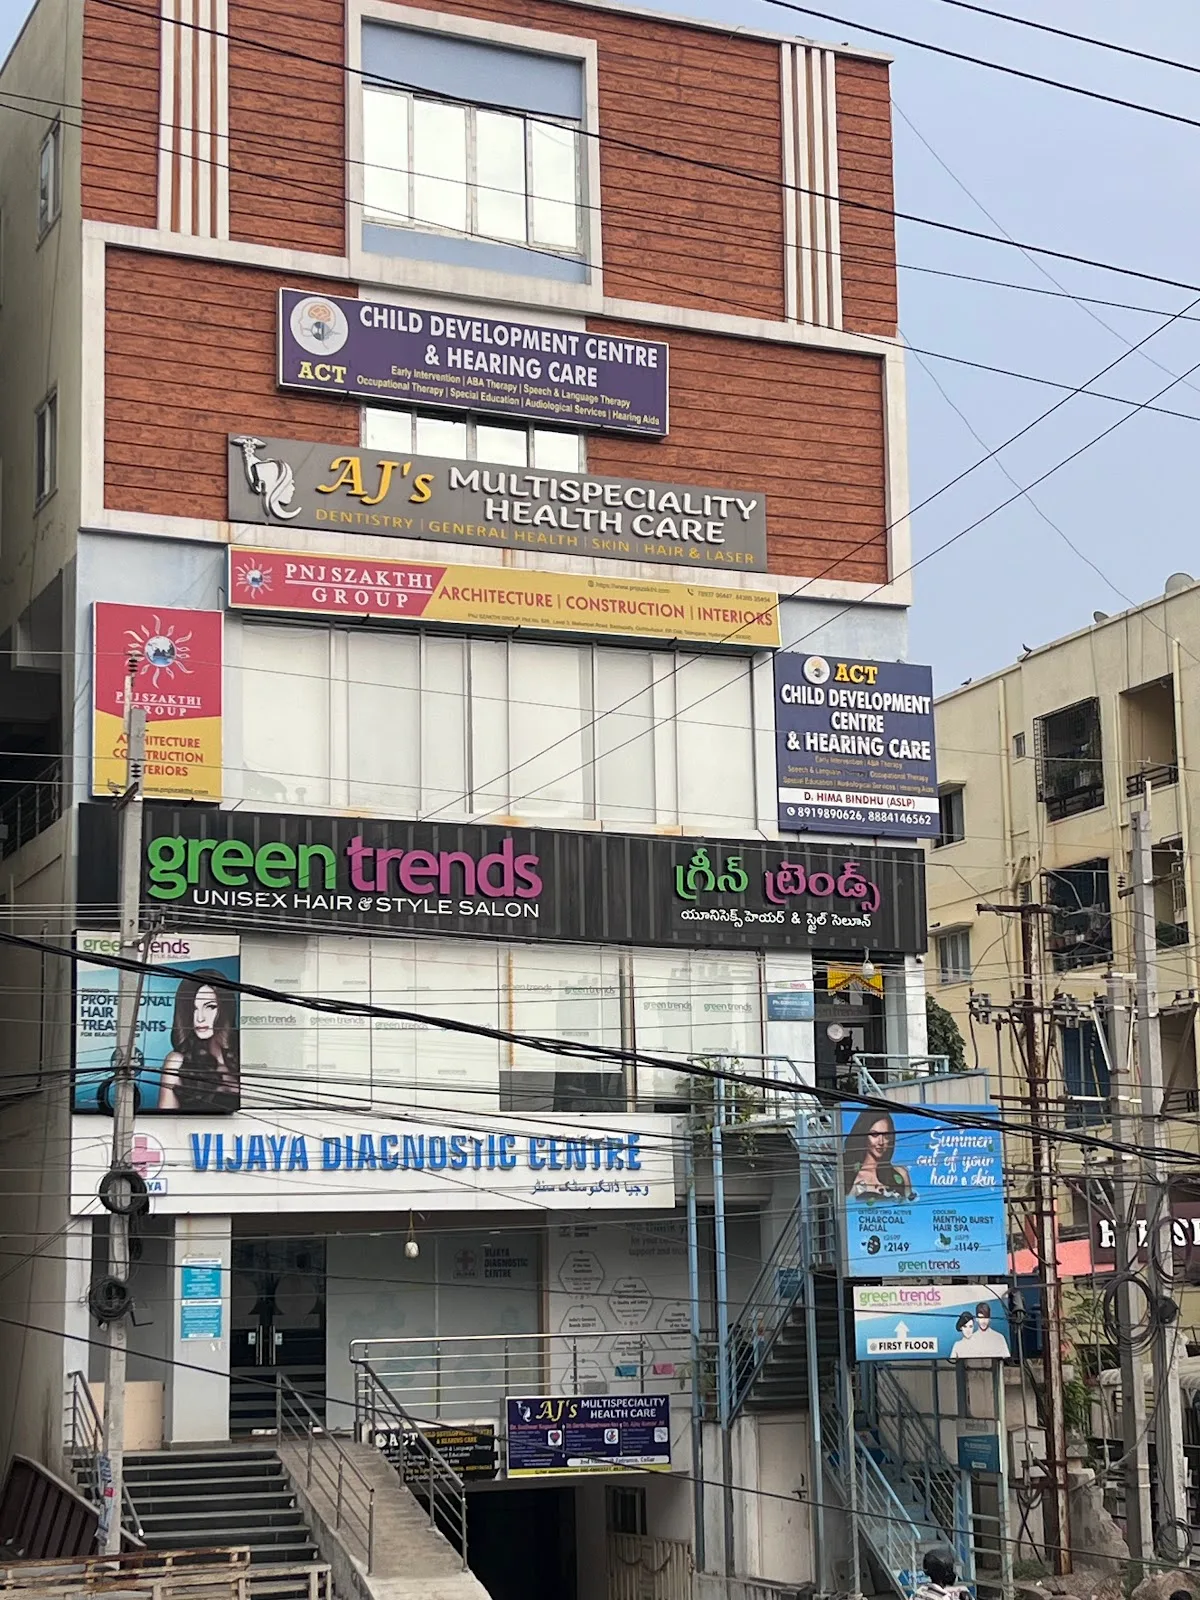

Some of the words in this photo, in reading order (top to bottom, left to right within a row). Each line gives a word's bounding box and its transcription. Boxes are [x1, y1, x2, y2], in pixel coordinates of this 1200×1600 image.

[359, 305, 424, 334] CHILD
[430, 313, 579, 357] DEVELOPMENT
[585, 339, 659, 369] CENTRE
[298, 362, 347, 384] ACT
[424, 344, 441, 366] &
[447, 346, 542, 377] HEARING
[548, 361, 598, 388] CARE
[391, 366, 413, 379] Early
[414, 369, 461, 384] Intervention
[466, 376, 485, 388] ABA
[486, 379, 518, 394] Therapy
[523, 384, 552, 397] Speech
[554, 388, 560, 398] &
[562, 389, 599, 405] Language
[600, 394, 632, 409] Therapy
[357, 375, 410, 391] Occupational
[412, 382, 445, 397] Therapy
[450, 387, 479, 400] Special
[480, 391, 520, 406] Education
[525, 397, 573, 413] Audiological
[574, 404, 607, 418] Services
[612, 411, 642, 425] Hearing
[643, 414, 660, 426] Aids
[315, 456, 436, 506] AJ's
[449, 466, 758, 522] MULTISPECIALITY
[485, 497, 623, 535] HEALTH
[632, 512, 727, 545] CARE
[315, 508, 414, 530] DENTISTRY
[429, 520, 509, 541] GENERAL
[514, 527, 578, 548] HEALTH
[592, 537, 630, 553] SKIN
[644, 542, 685, 559] HAIR
[688, 546, 700, 560] &
[706, 548, 755, 565] LASER
[311, 587, 409, 608] GROUP
[439, 584, 554, 609] ARCHITECTURE
[565, 594, 685, 620] CONSTRUCTION
[697, 606, 773, 627] INTERIORS
[834, 663, 878, 685] ACT
[781, 684, 825, 705] CHILD
[829, 688, 931, 714] DEVELOPMENT
[831, 711, 885, 733] CENTRE
[116, 735, 201, 749] AHITECTURE
[787, 730, 801, 750] &
[806, 732, 885, 757] HEARING
[889, 738, 932, 761] CARE
[112, 748, 204, 763] COTRUCTION
[803, 791, 814, 802] D.
[816, 792, 843, 804] HIMA
[845, 794, 885, 806] BINDHU
[886, 796, 916, 809] (ASLP)
[797, 807, 866, 823] 8919890626,
[868, 811, 932, 826] 8884146562
[147, 836, 337, 899] green
[347, 836, 543, 898] trends
[193, 888, 287, 909] UNISEX
[294, 894, 353, 911] HAIR
[376, 897, 453, 915] STYLE
[458, 900, 540, 919] SALON
[791, 911, 802, 925] &
[83, 939, 121, 953] gree
[80, 995, 172, 1007] PROFEONAL
[643, 1001, 667, 1010] green
[704, 1003, 728, 1012] green
[728, 1002, 752, 1011] trends
[80, 1006, 114, 1018] HAIR
[268, 1015, 297, 1024] trends
[929, 1126, 993, 1150] Summer
[191, 1132, 309, 1173] VIJAYA
[320, 1133, 518, 1172] DIAGNOSTIC
[527, 1131, 643, 1171] CENTRE
[944, 1149, 960, 1172] of
[962, 1155, 995, 1172] your
[930, 1168, 958, 1185] hair
[970, 1169, 997, 1187] skin
[858, 1216, 905, 1224] CHARCOAL
[859, 1224, 888, 1232] FACIAL
[932, 1216, 967, 1224] MENTHO
[969, 1216, 995, 1224] BURST
[933, 1224, 952, 1232] HAIR
[953, 1224, 970, 1232] SPA
[898, 1260, 927, 1273] green
[928, 1258, 961, 1271] trends
[859, 1289, 898, 1307] green
[899, 1286, 941, 1303] trends
[878, 1341, 903, 1351] FIRST
[904, 1341, 935, 1351] FLOOR
[535, 1400, 578, 1422] AJ's
[581, 1397, 666, 1409] MULTISPECIALITY
[590, 1408, 628, 1419] HEALTH
[629, 1408, 657, 1418] CARE
